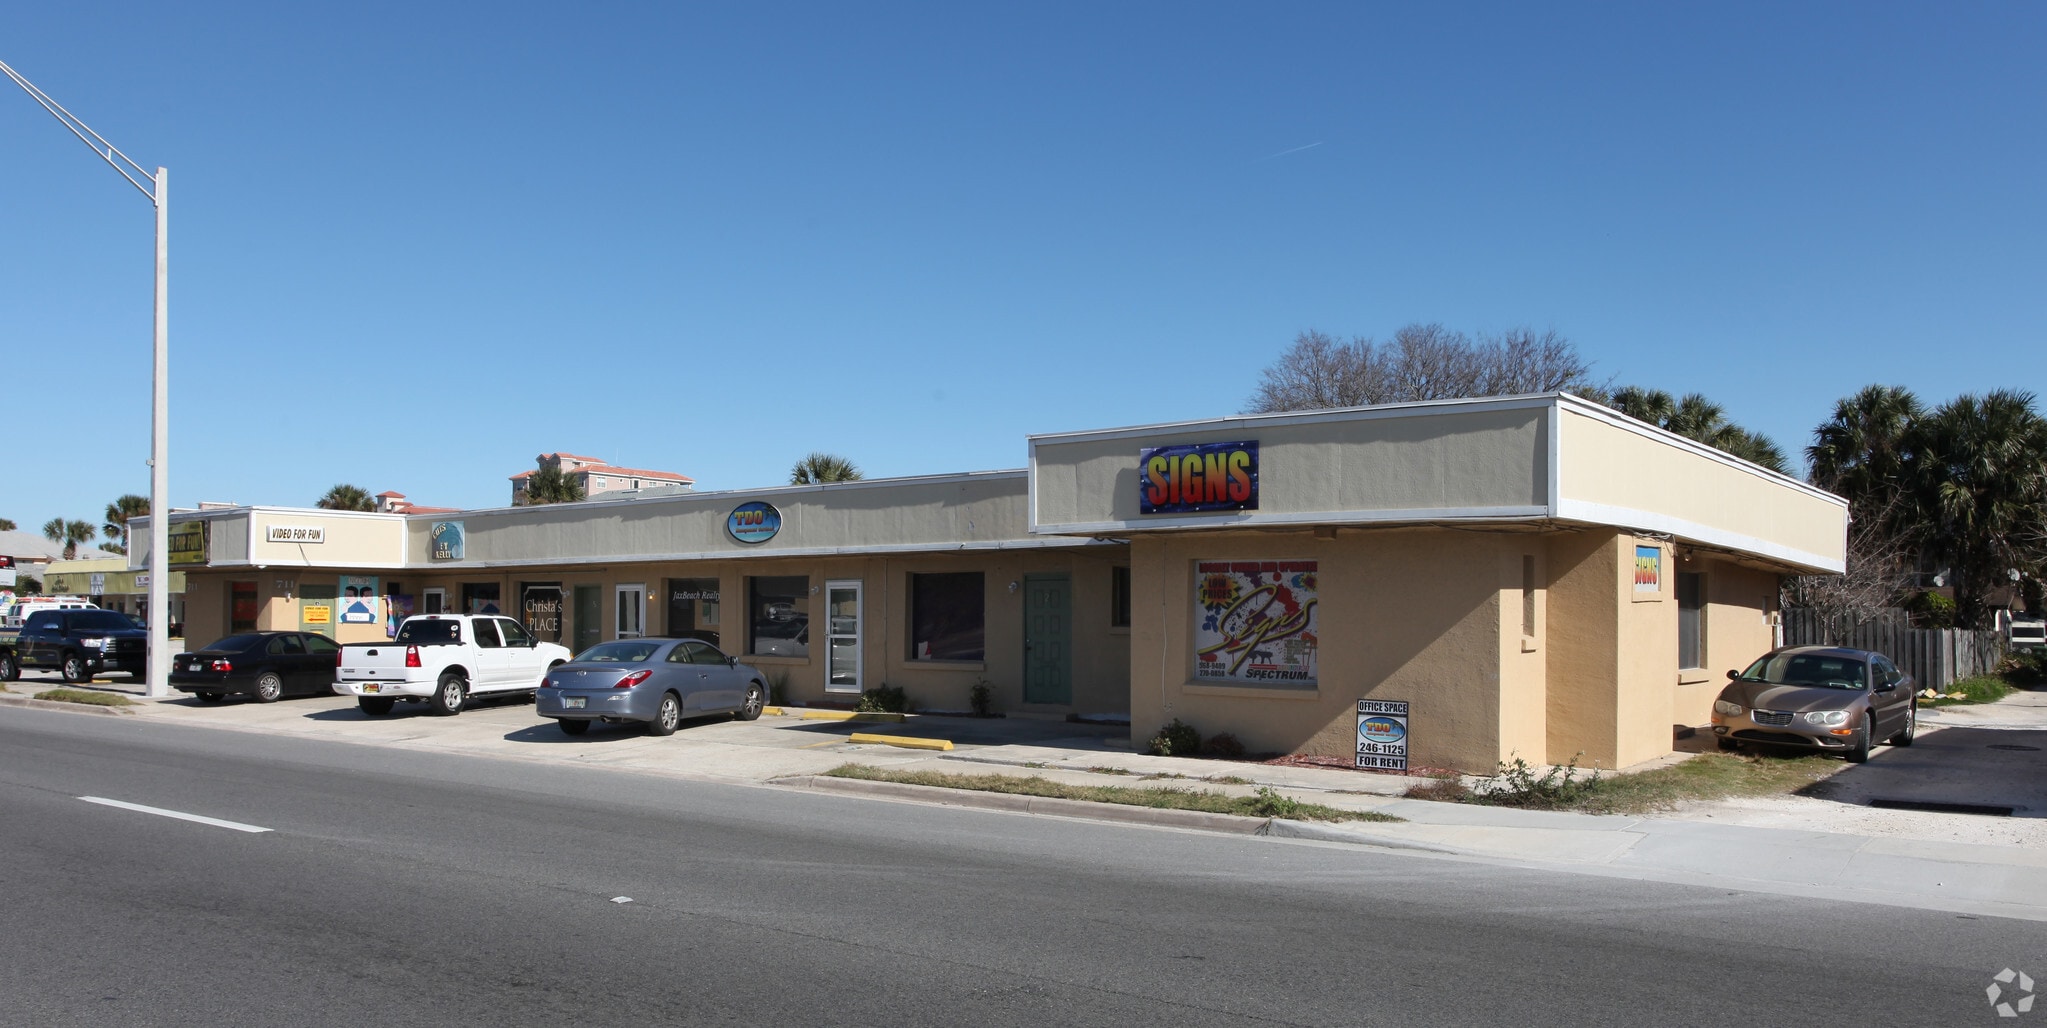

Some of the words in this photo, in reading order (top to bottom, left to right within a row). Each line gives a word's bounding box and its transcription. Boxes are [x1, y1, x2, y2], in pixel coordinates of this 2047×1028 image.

[1147, 450, 1251, 505] SIGNS
[734, 510, 763, 526] TDO
[272, 528, 291, 539] VIDEO
[293, 529, 306, 539] FOR
[308, 529, 321, 539] FUN
[435, 551, 451, 559] KELLY
[1635, 557, 1657, 584] SIGNS
[276, 579, 294, 589] 711
[1208, 578, 1226, 588] LOW
[672, 591, 701, 601] JaxBeach
[1202, 589, 1233, 599] PRICES
[525, 598, 562, 613] Christa's
[529, 617, 558, 632] PLACE
[1197, 584, 1318, 675] Signs
[1246, 669, 1308, 680] SPECTRUM
[1359, 701, 1383, 711] OFFICE
[1384, 702, 1407, 713] SPACE
[1365, 722, 1391, 733] TDO
[1360, 743, 1404, 755] 246-1125
[1360, 756, 1378, 767] FOR
[1380, 758, 1404, 768] RENT
